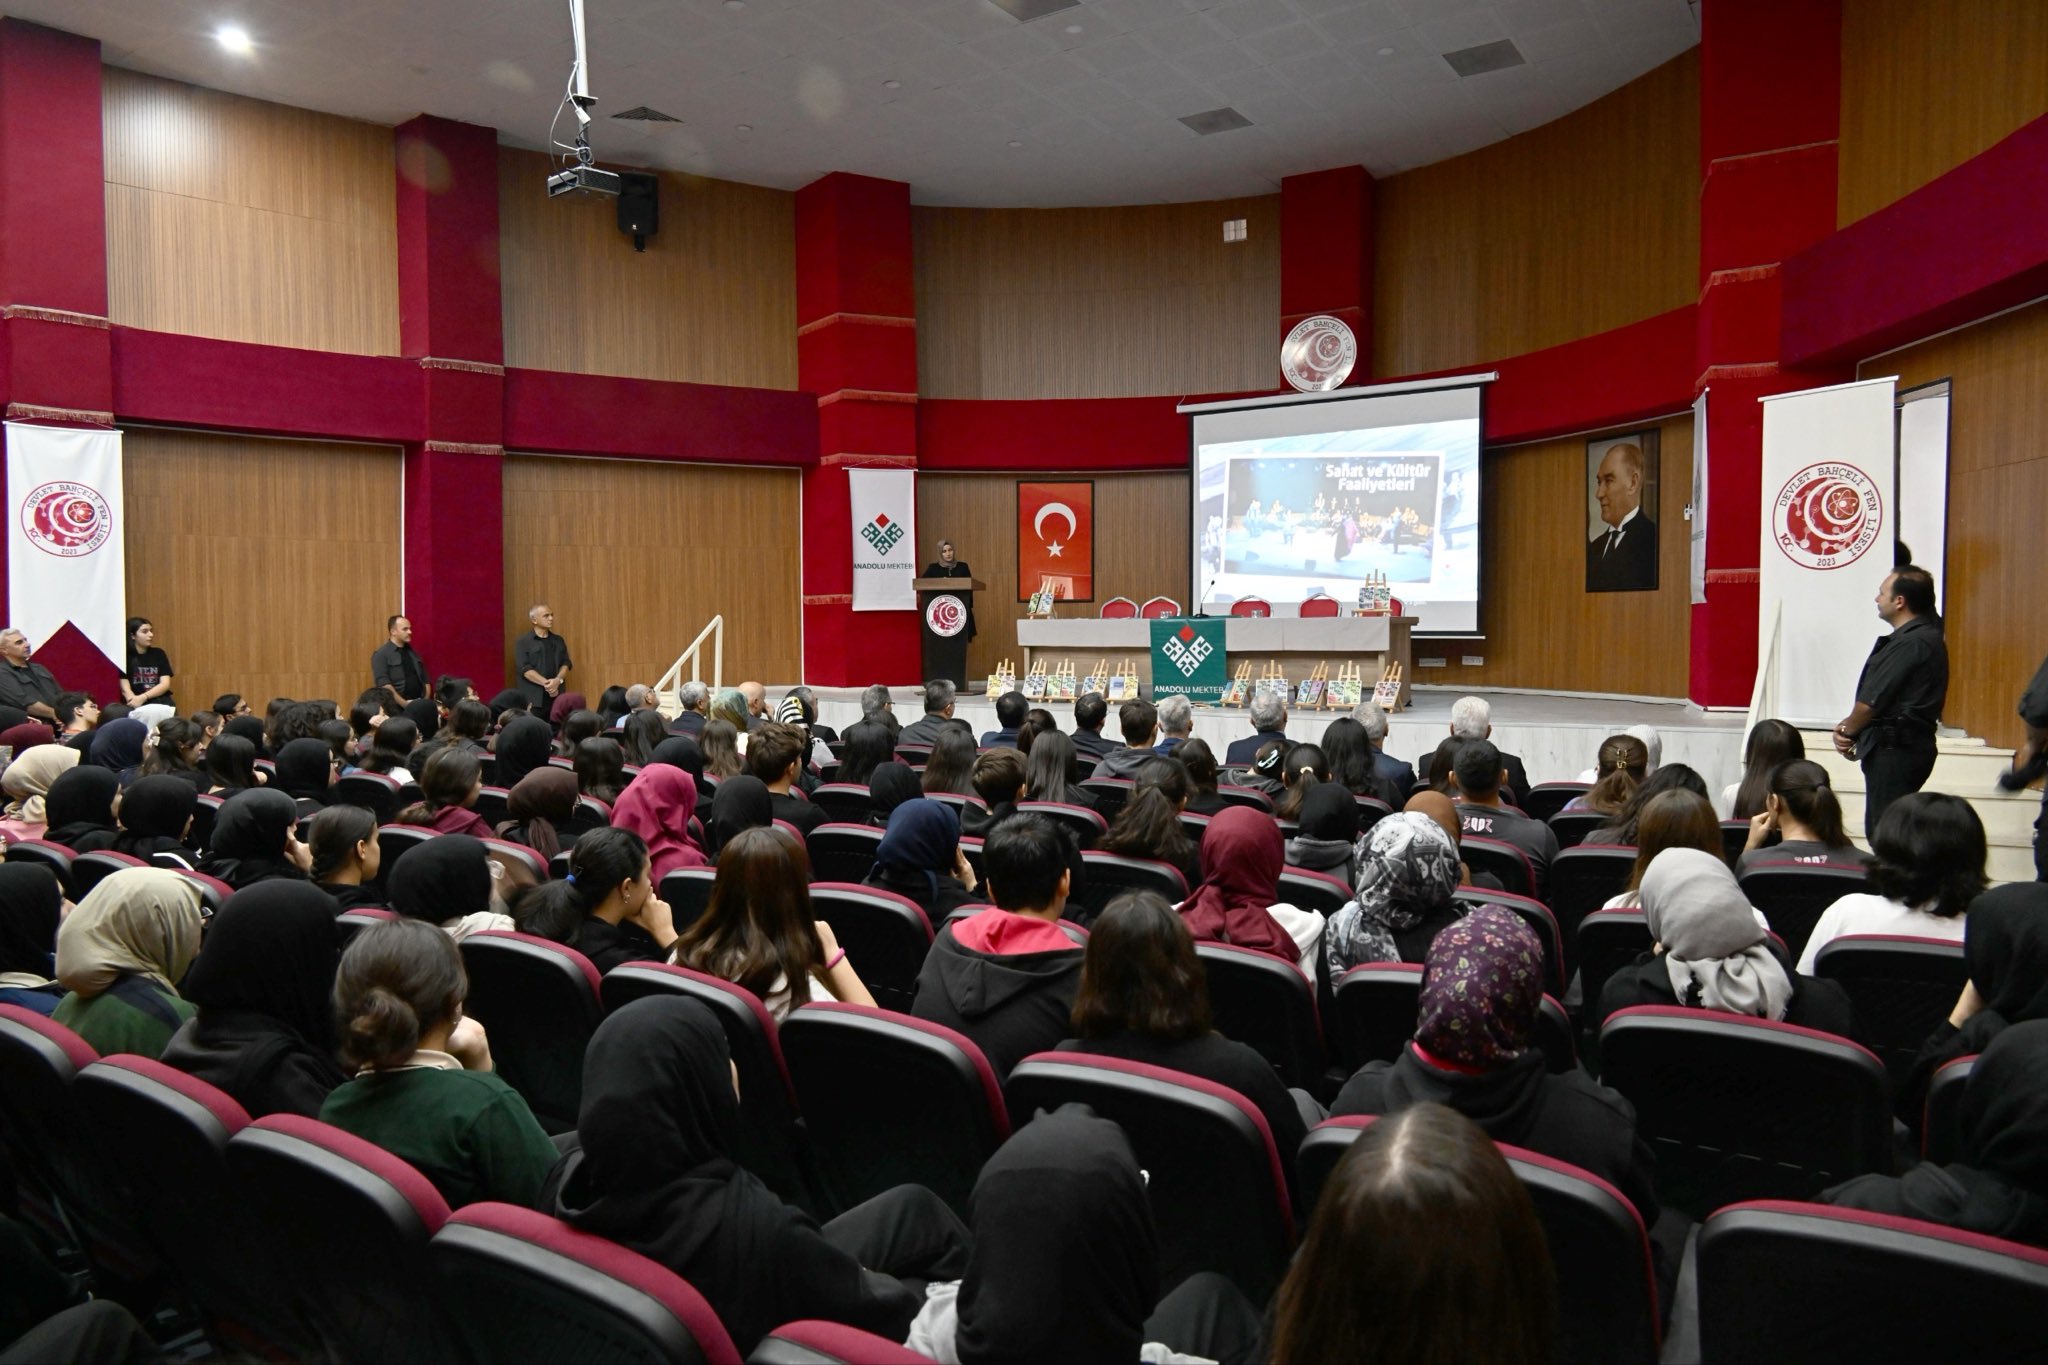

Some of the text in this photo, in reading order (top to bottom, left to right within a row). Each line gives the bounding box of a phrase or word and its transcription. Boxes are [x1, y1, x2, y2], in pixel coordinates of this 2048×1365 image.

[1325, 463, 1364, 477] Sanat
[1366, 466, 1383, 477] ve
[1338, 477, 1415, 493] Faaliyetleri
[27, 486, 53, 508] DEVLET
[97, 505, 108, 520] FEN
[1779, 466, 1878, 558] DEVLET BAHÇELİ FEN LİSESİ
[1816, 557, 1836, 567] 2023
[1154, 685, 1224, 694] ANADOLU MEKTEB
